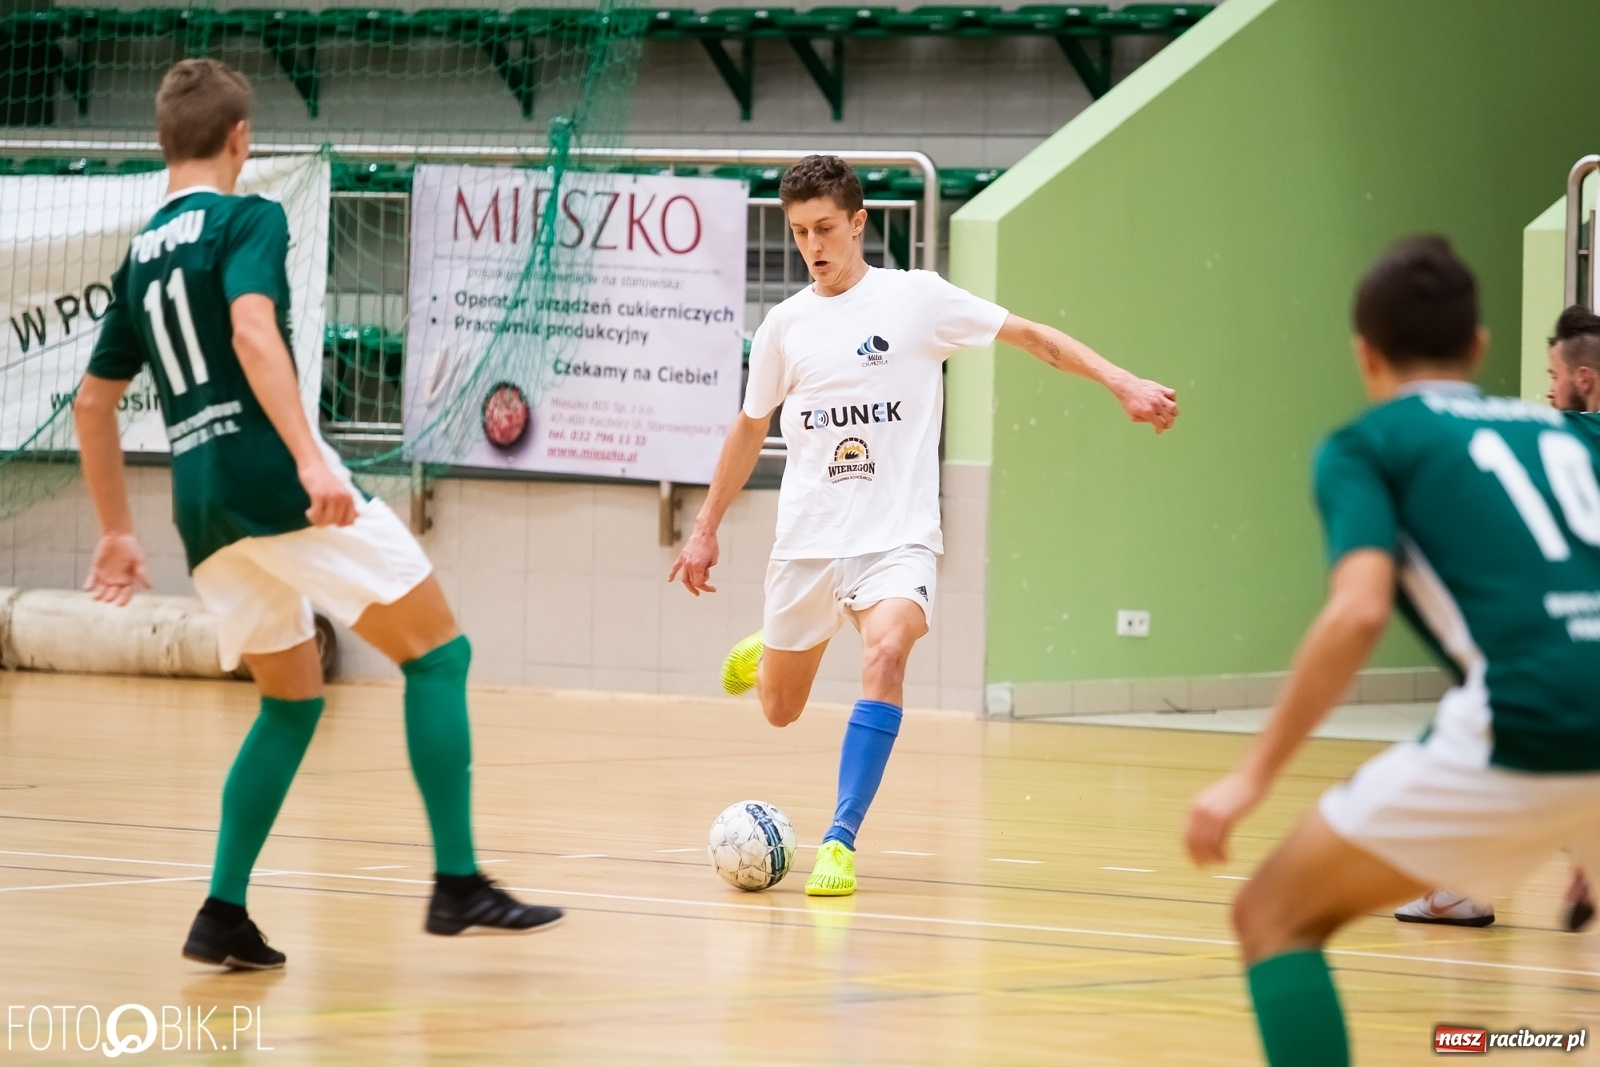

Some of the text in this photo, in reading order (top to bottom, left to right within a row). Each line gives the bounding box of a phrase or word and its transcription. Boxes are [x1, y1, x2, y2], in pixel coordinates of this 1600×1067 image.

[453, 186, 702, 257] MIESZKO
[617, 302, 734, 325] cukierniczych
[10, 306, 46, 353] W
[143, 267, 209, 396] 11
[546, 320, 649, 345] produkcyjny
[552, 358, 718, 386] Czekamy na Ciebie!
[800, 400, 902, 430] ZDUNEK
[828, 461, 876, 478] WIERZGOŃ
